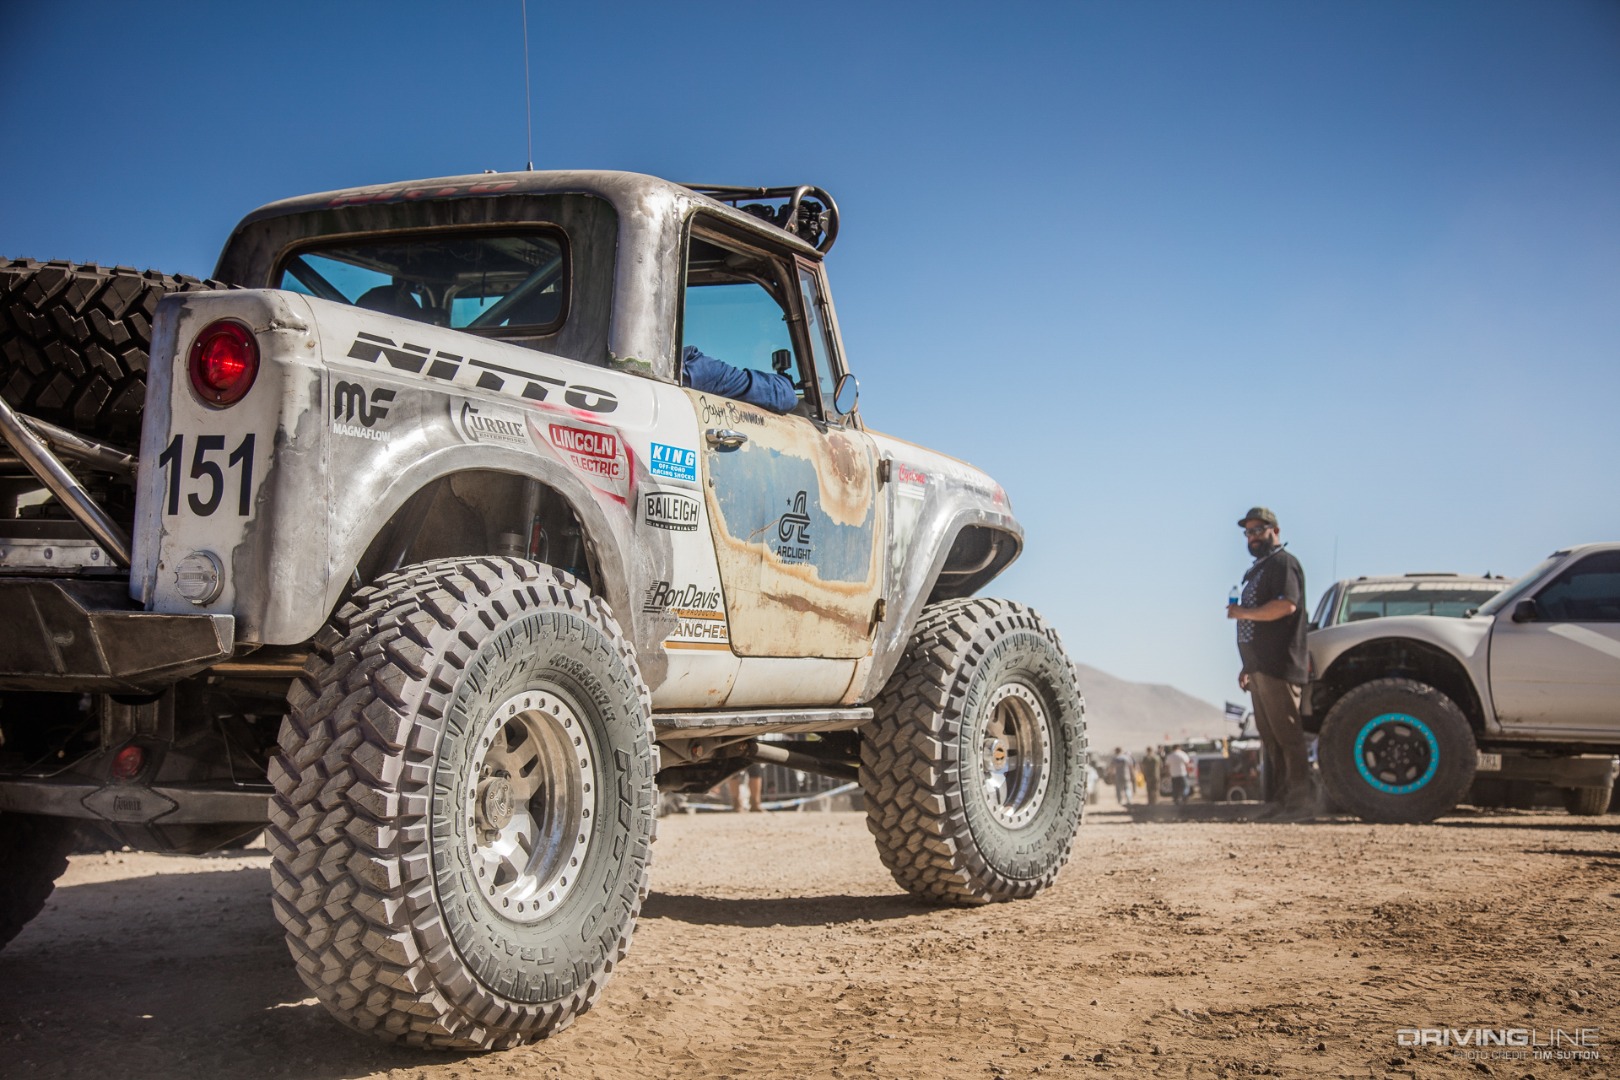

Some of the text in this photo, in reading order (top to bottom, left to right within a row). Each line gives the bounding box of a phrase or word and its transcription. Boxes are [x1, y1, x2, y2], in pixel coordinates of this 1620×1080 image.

[347, 331, 619, 414] NITTO
[333, 422, 391, 442] MAGNAFLOW
[460, 400, 525, 443] CURRIE
[479, 432, 528, 446] ENTERPRISES
[552, 427, 613, 457] LINCOLN
[570, 455, 619, 476] ELECTRIC
[652, 445, 695, 467] KING
[159, 433, 256, 517] 151
[652, 467, 695, 481] RACING SHOCKS
[658, 462, 686, 474] OFF-ROAD
[647, 496, 698, 522] BAILEIGH
[776, 545, 812, 561] ARCLIGHT
[669, 622, 720, 639] ANCHE
[581, 748, 634, 943] NITTO
